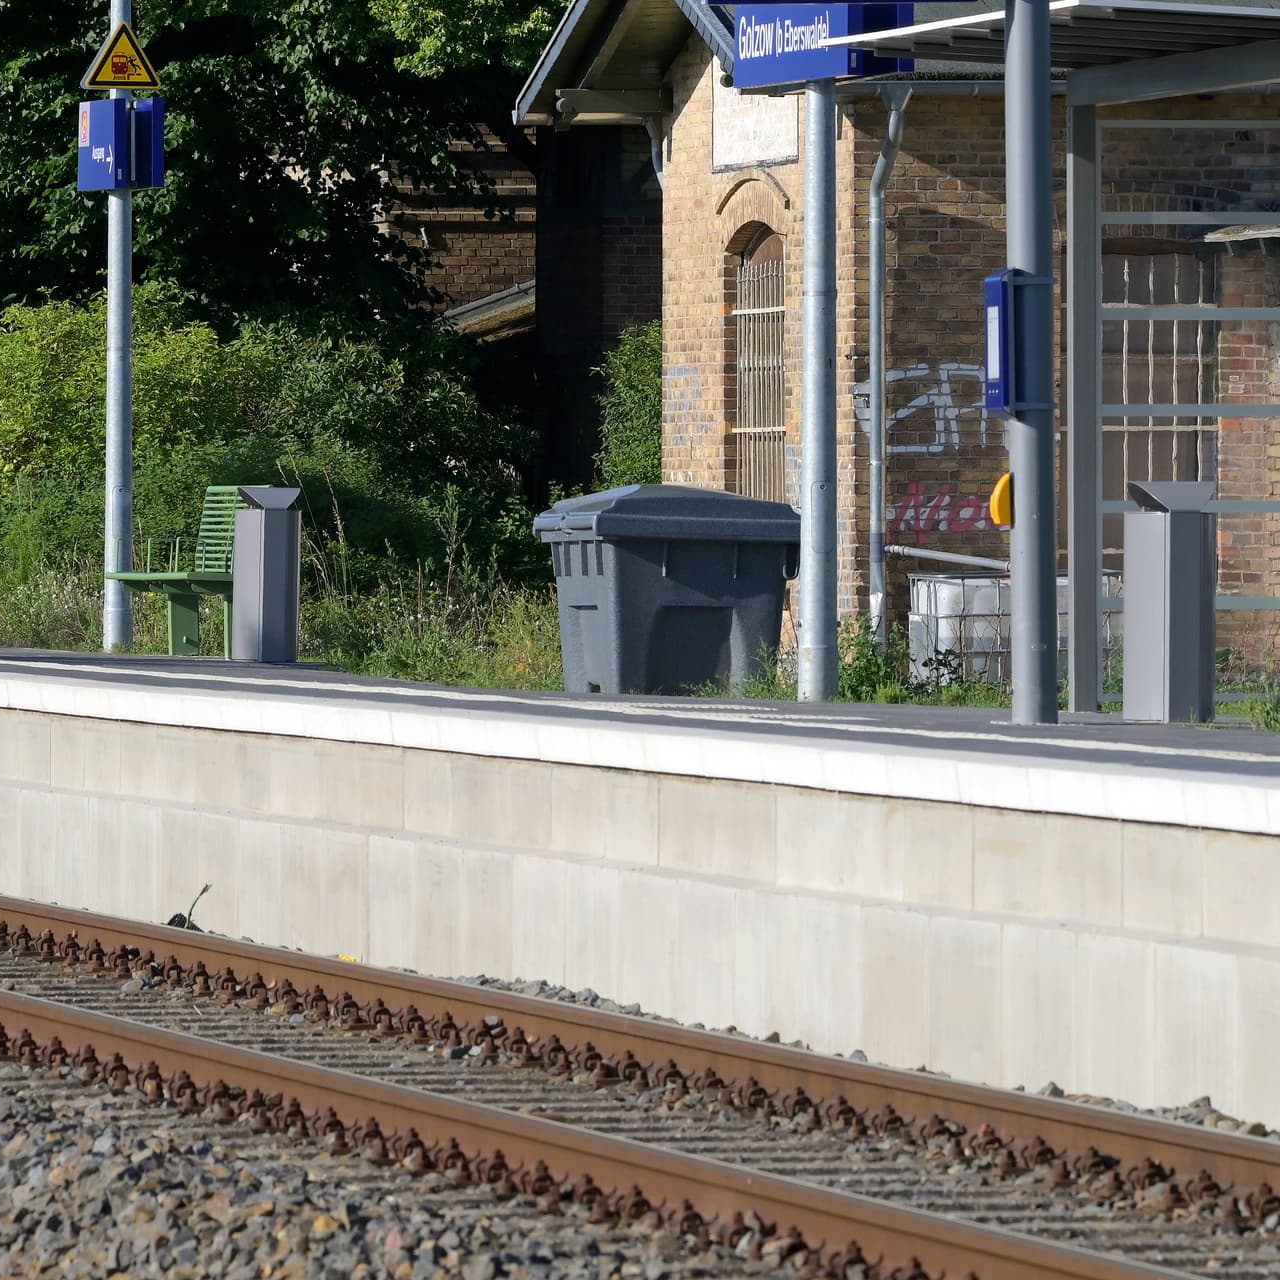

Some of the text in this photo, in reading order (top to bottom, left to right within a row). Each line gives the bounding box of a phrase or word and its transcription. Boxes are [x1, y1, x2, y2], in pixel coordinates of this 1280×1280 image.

[739, 9, 829, 60] Golzow (b Eberswalde)
